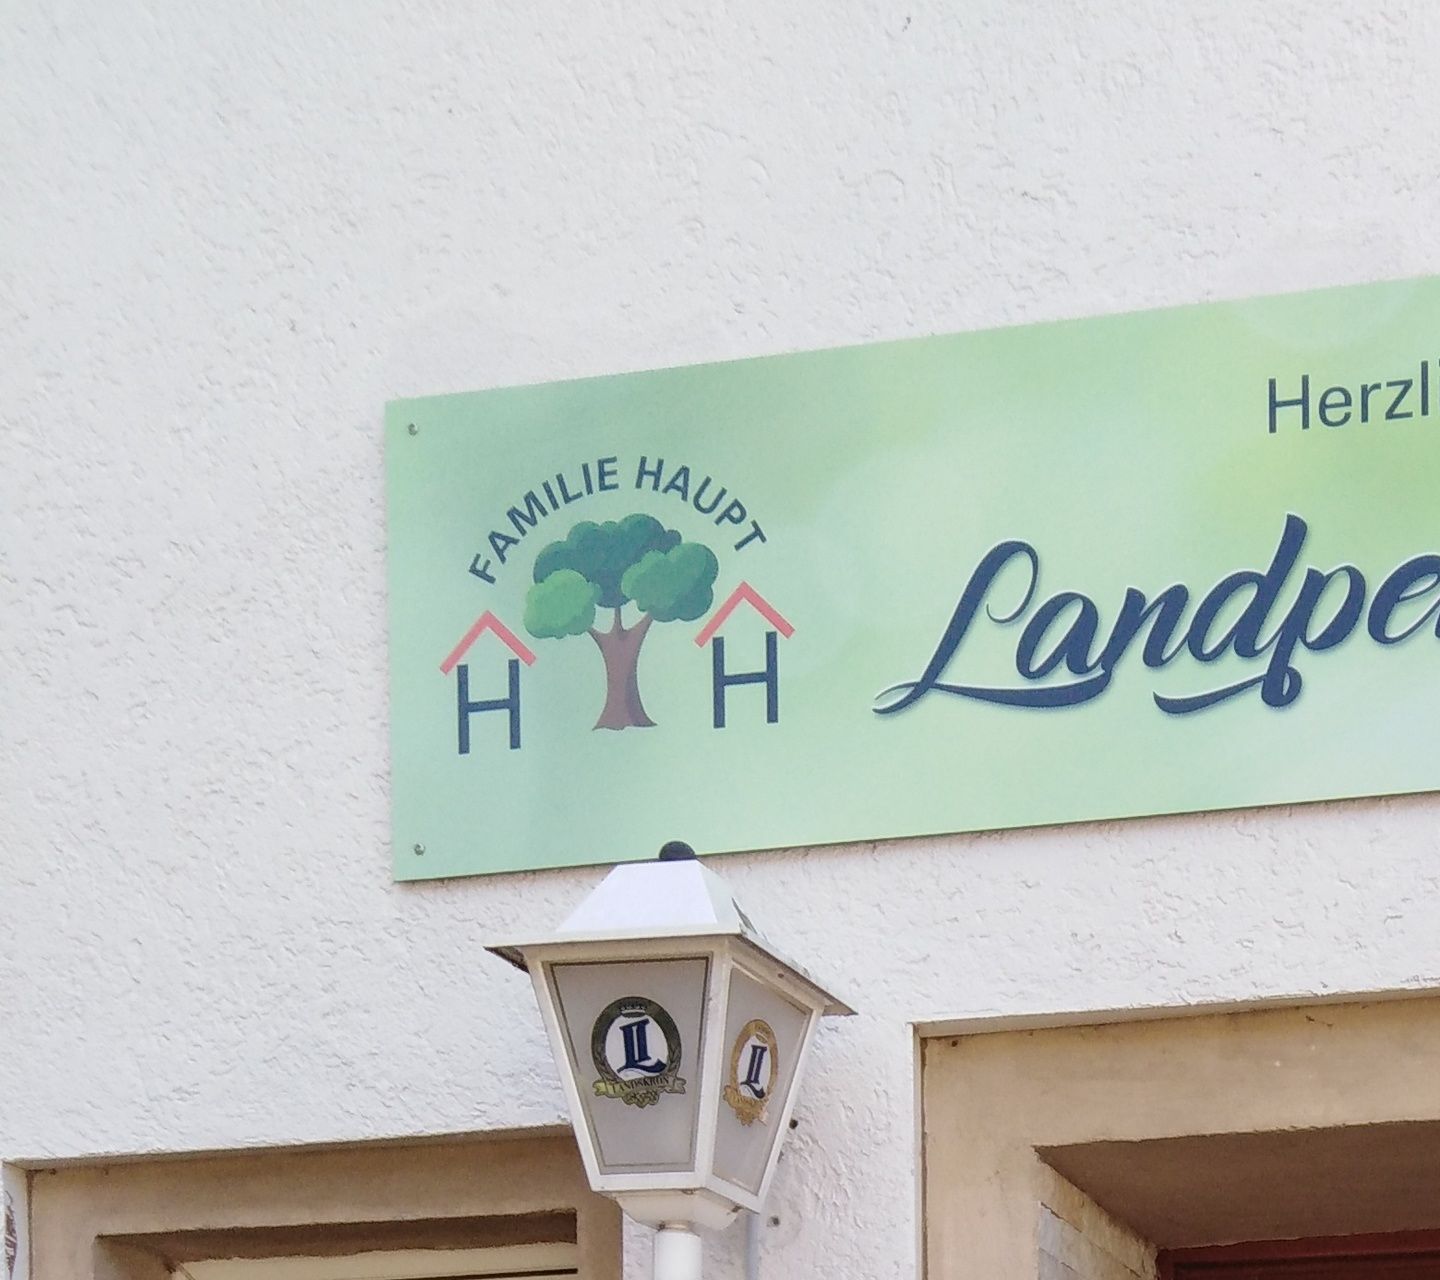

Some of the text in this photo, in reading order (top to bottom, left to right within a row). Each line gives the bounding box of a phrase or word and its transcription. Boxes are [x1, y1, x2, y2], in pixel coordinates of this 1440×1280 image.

[468, 455, 768, 585] FAMILIE HAUPT
[456, 631, 780, 756] H H
